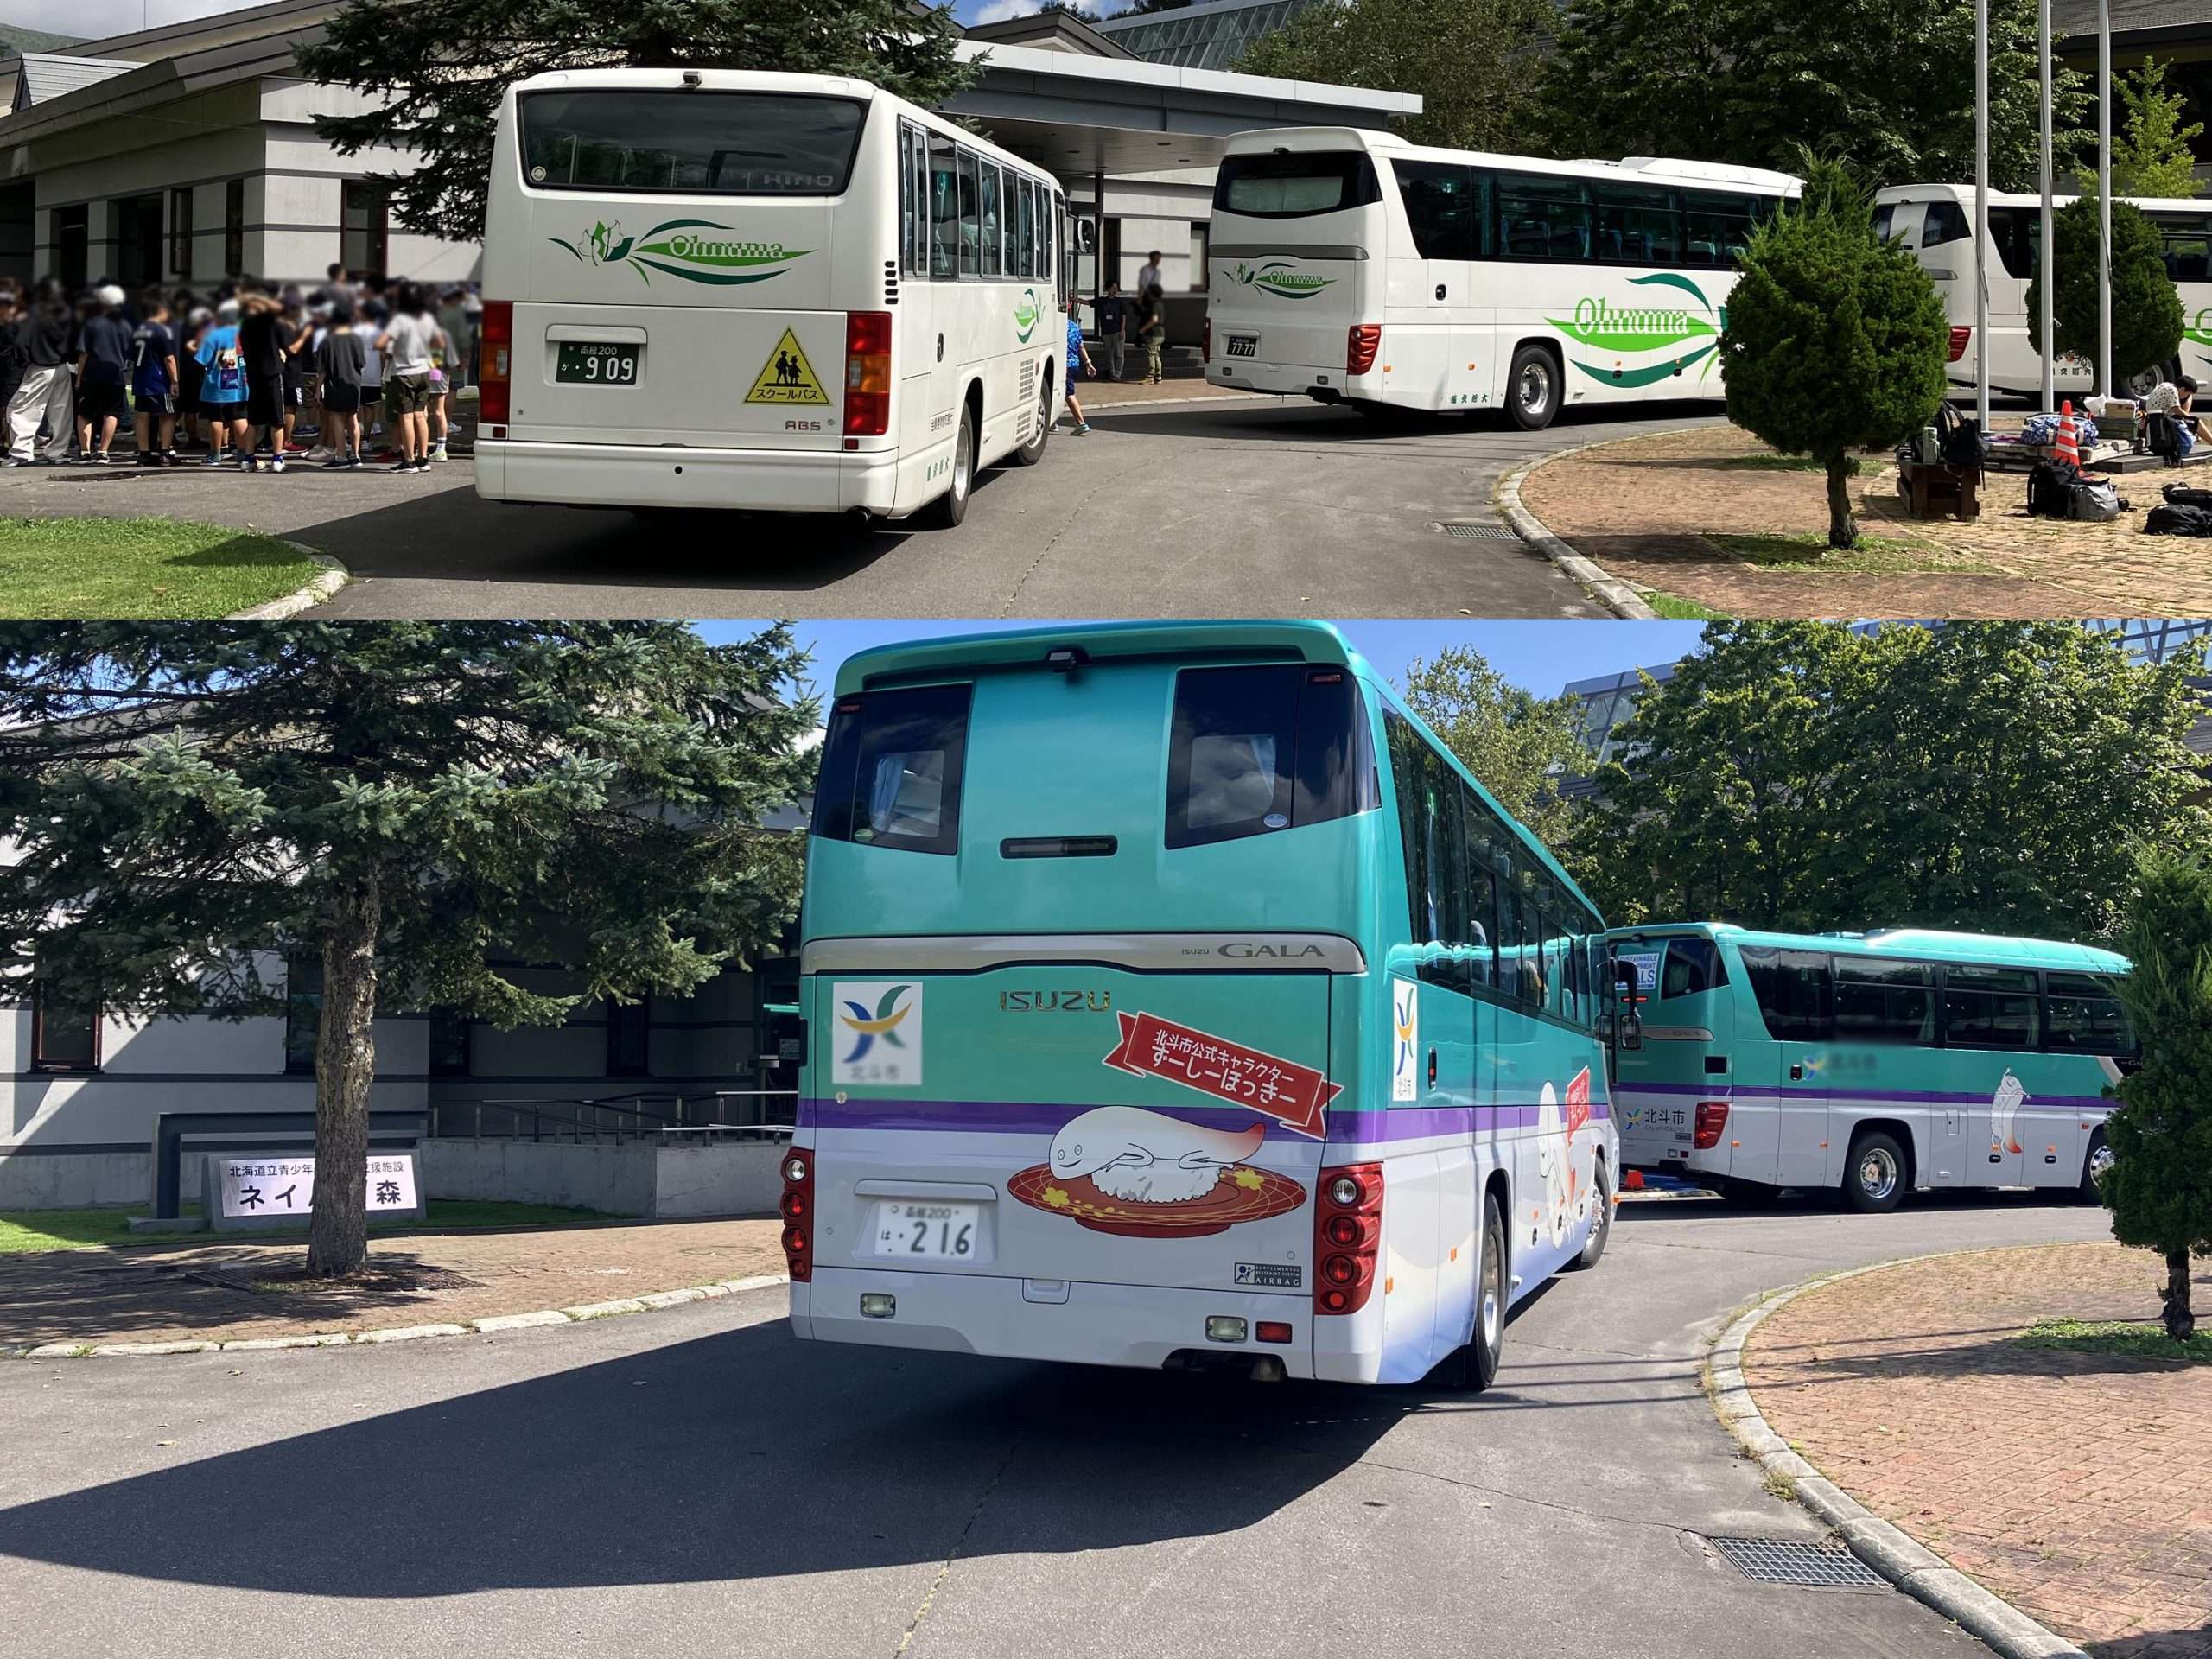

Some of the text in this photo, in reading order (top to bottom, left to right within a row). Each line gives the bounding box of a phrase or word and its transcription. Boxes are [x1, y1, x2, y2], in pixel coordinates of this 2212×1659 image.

[764, 174, 834, 187] HINO
[670, 234, 785, 259] Ohnuma
[1269, 270, 1324, 285] Ohnuma
[1574, 297, 1690, 336] Ohnuma
[135, 340, 146, 367] 7
[755, 389, 818, 400] スクールバス
[785, 420, 822, 431] ABS
[1217, 943, 1325, 958] GALA
[1000, 990, 1111, 1012] ISUZU
[1154, 1029, 1294, 1083] 北斗市公式キャラクター
[1151, 1045, 1297, 1104] ずーしーほっきー
[1644, 1107, 1688, 1125] 北斗市
[1255, 1277, 1300, 1287] AIRBAG
